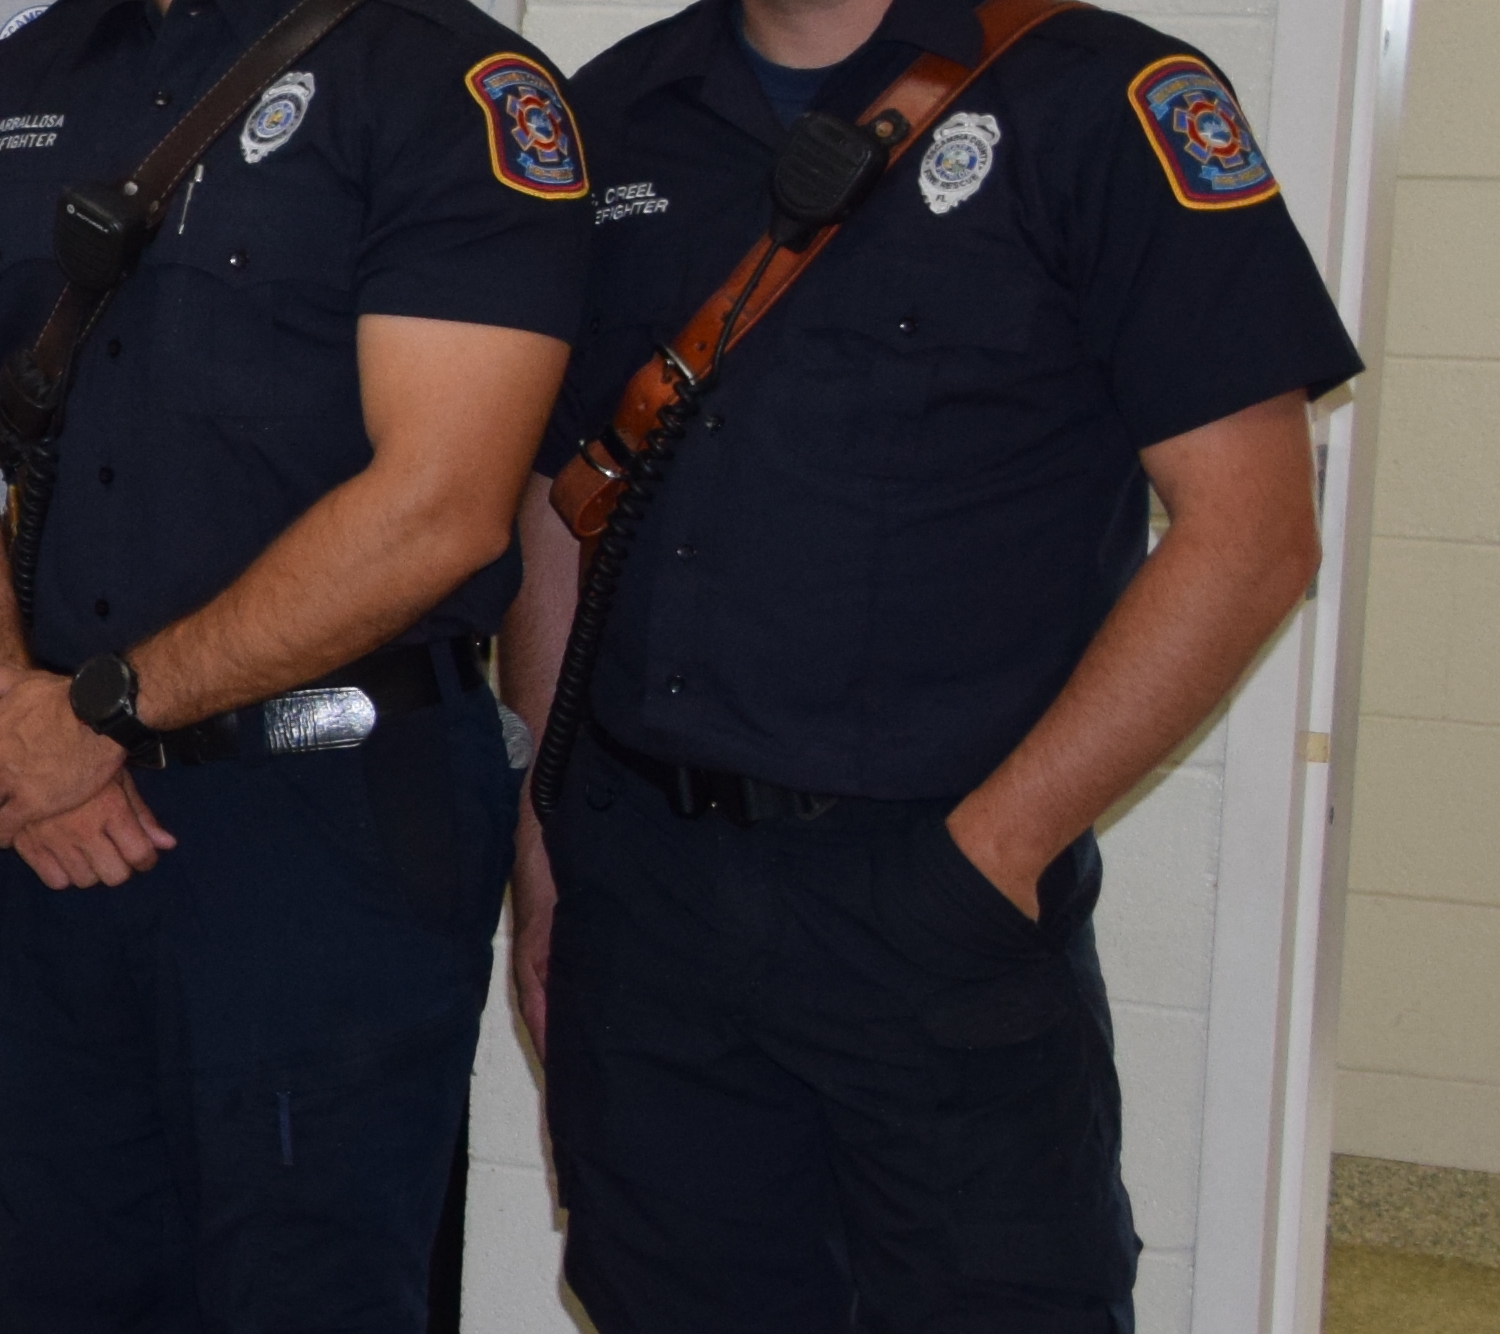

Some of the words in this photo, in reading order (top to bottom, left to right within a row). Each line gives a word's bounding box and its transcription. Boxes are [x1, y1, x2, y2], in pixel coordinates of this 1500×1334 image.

[940, 174, 979, 189] RESCUE
[605, 183, 656, 204] CREEL
[595, 199, 669, 225] EFIGHTER
